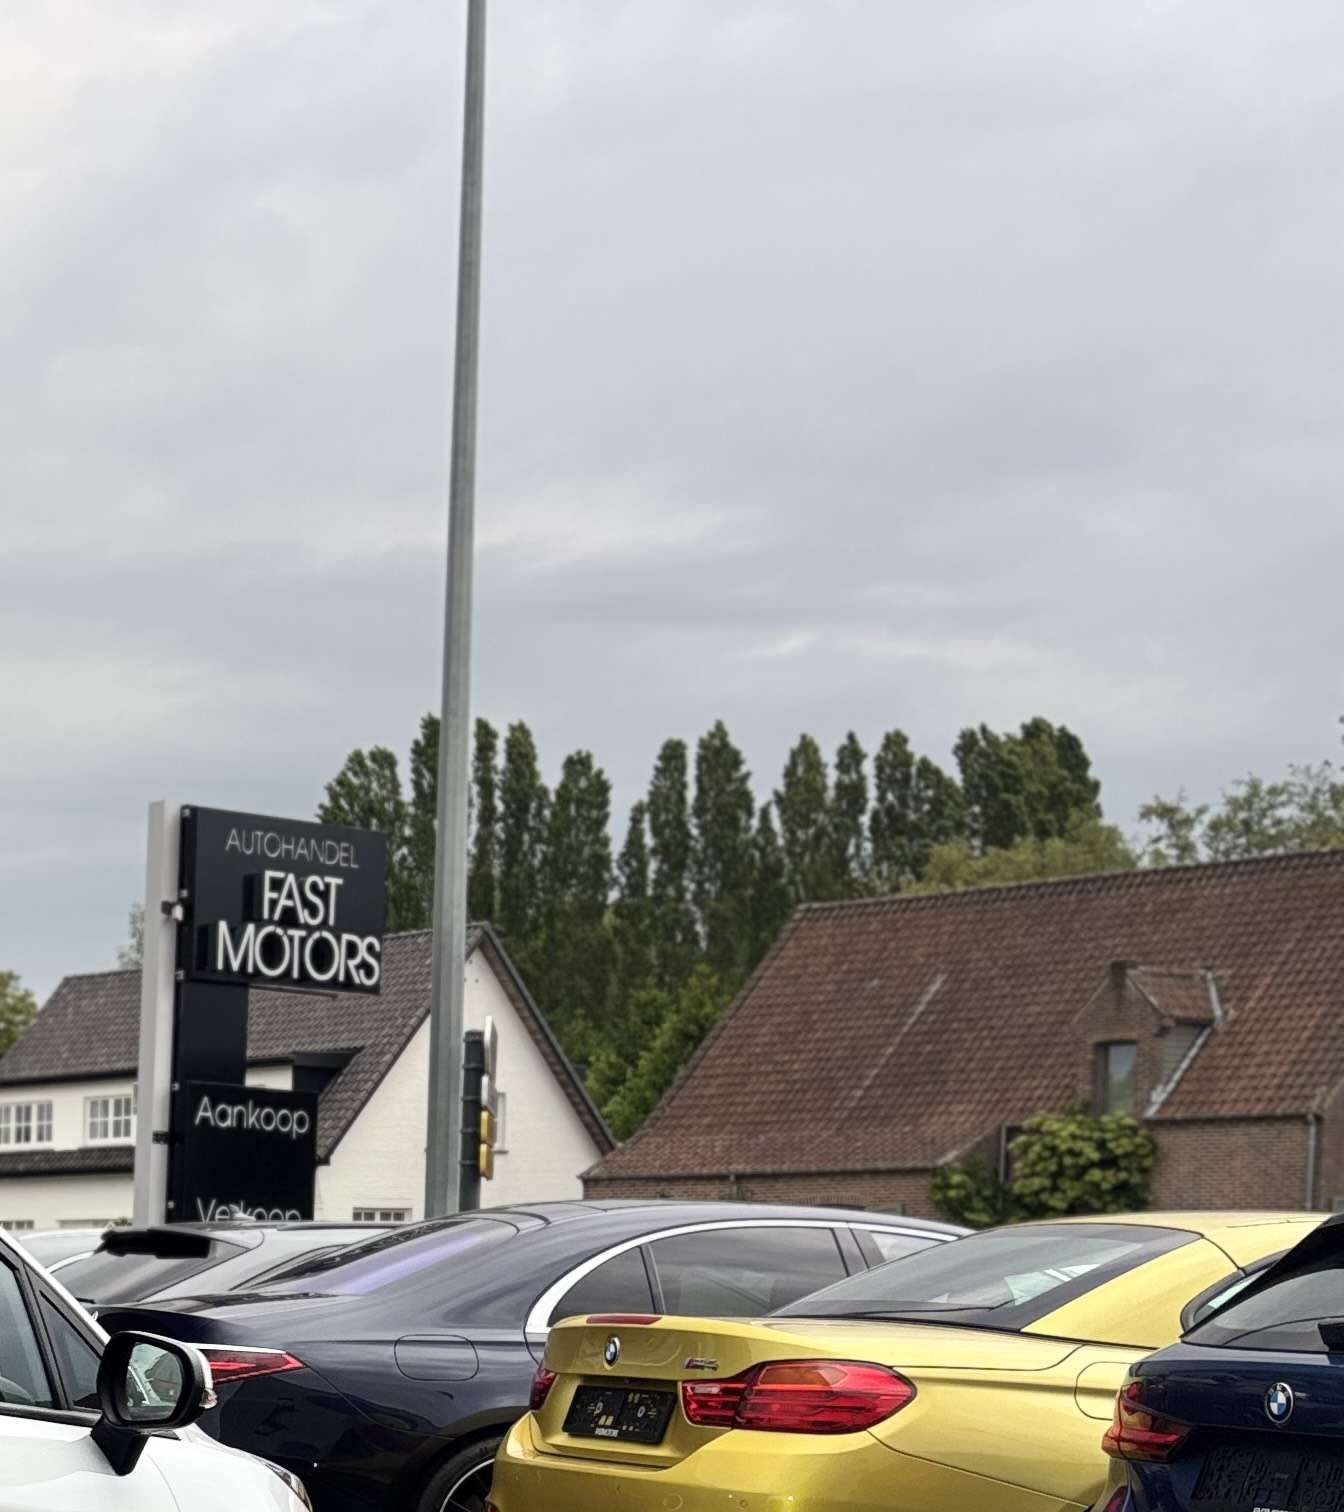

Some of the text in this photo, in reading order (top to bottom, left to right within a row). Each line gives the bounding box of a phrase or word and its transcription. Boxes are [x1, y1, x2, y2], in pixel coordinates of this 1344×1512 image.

[225, 828, 359, 869] AUTOHANDEL
[262, 870, 343, 926] FAST
[216, 920, 381, 986] MOTORS
[194, 1096, 309, 1140] Aankoop
